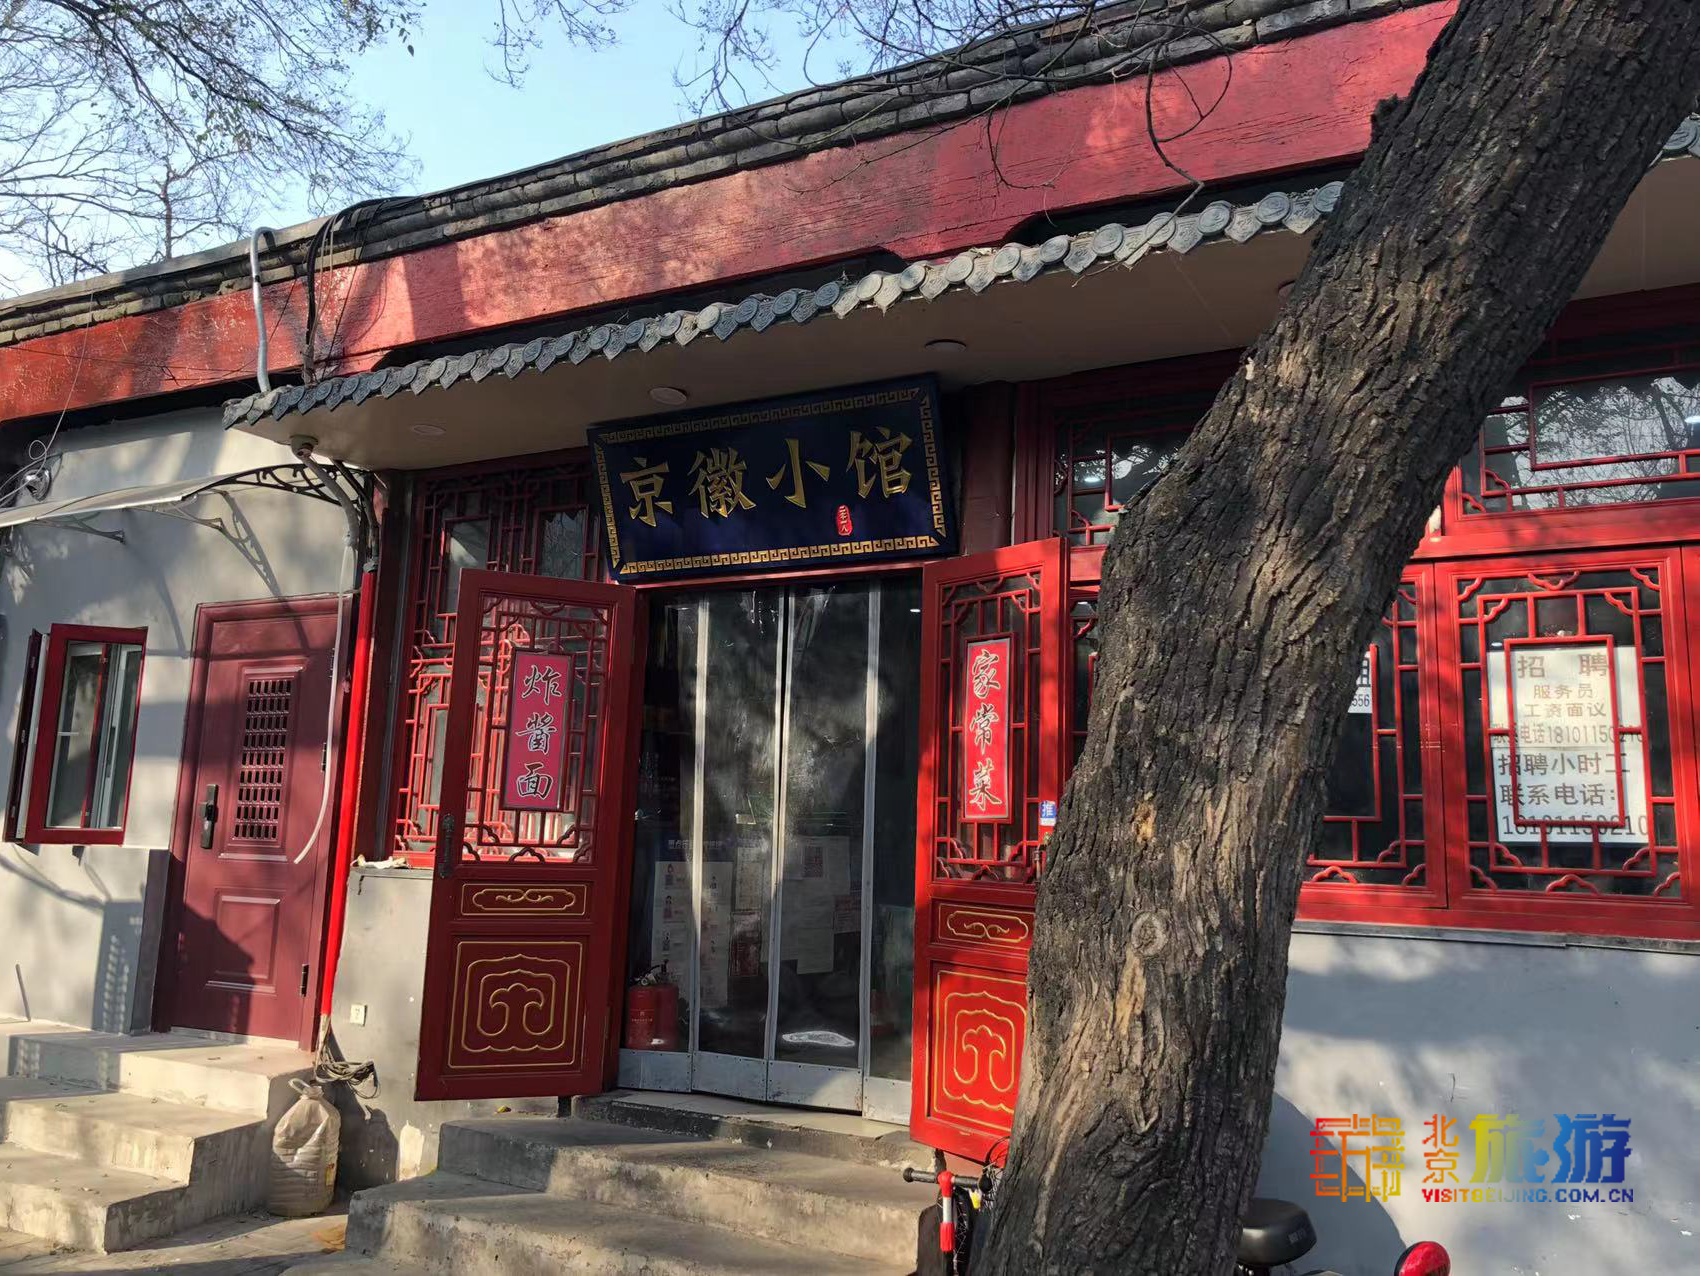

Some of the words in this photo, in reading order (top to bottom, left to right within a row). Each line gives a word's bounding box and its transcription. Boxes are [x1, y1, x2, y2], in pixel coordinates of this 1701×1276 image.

[620, 427, 914, 528] 京徽小馆
[1517, 653, 1609, 678] 招聘
[1533, 683, 1594, 699] 服务员
[1523, 702, 1607, 718] 工资面议
[969, 649, 1002, 811] 家常菜
[1041, 801, 1054, 817] 推
